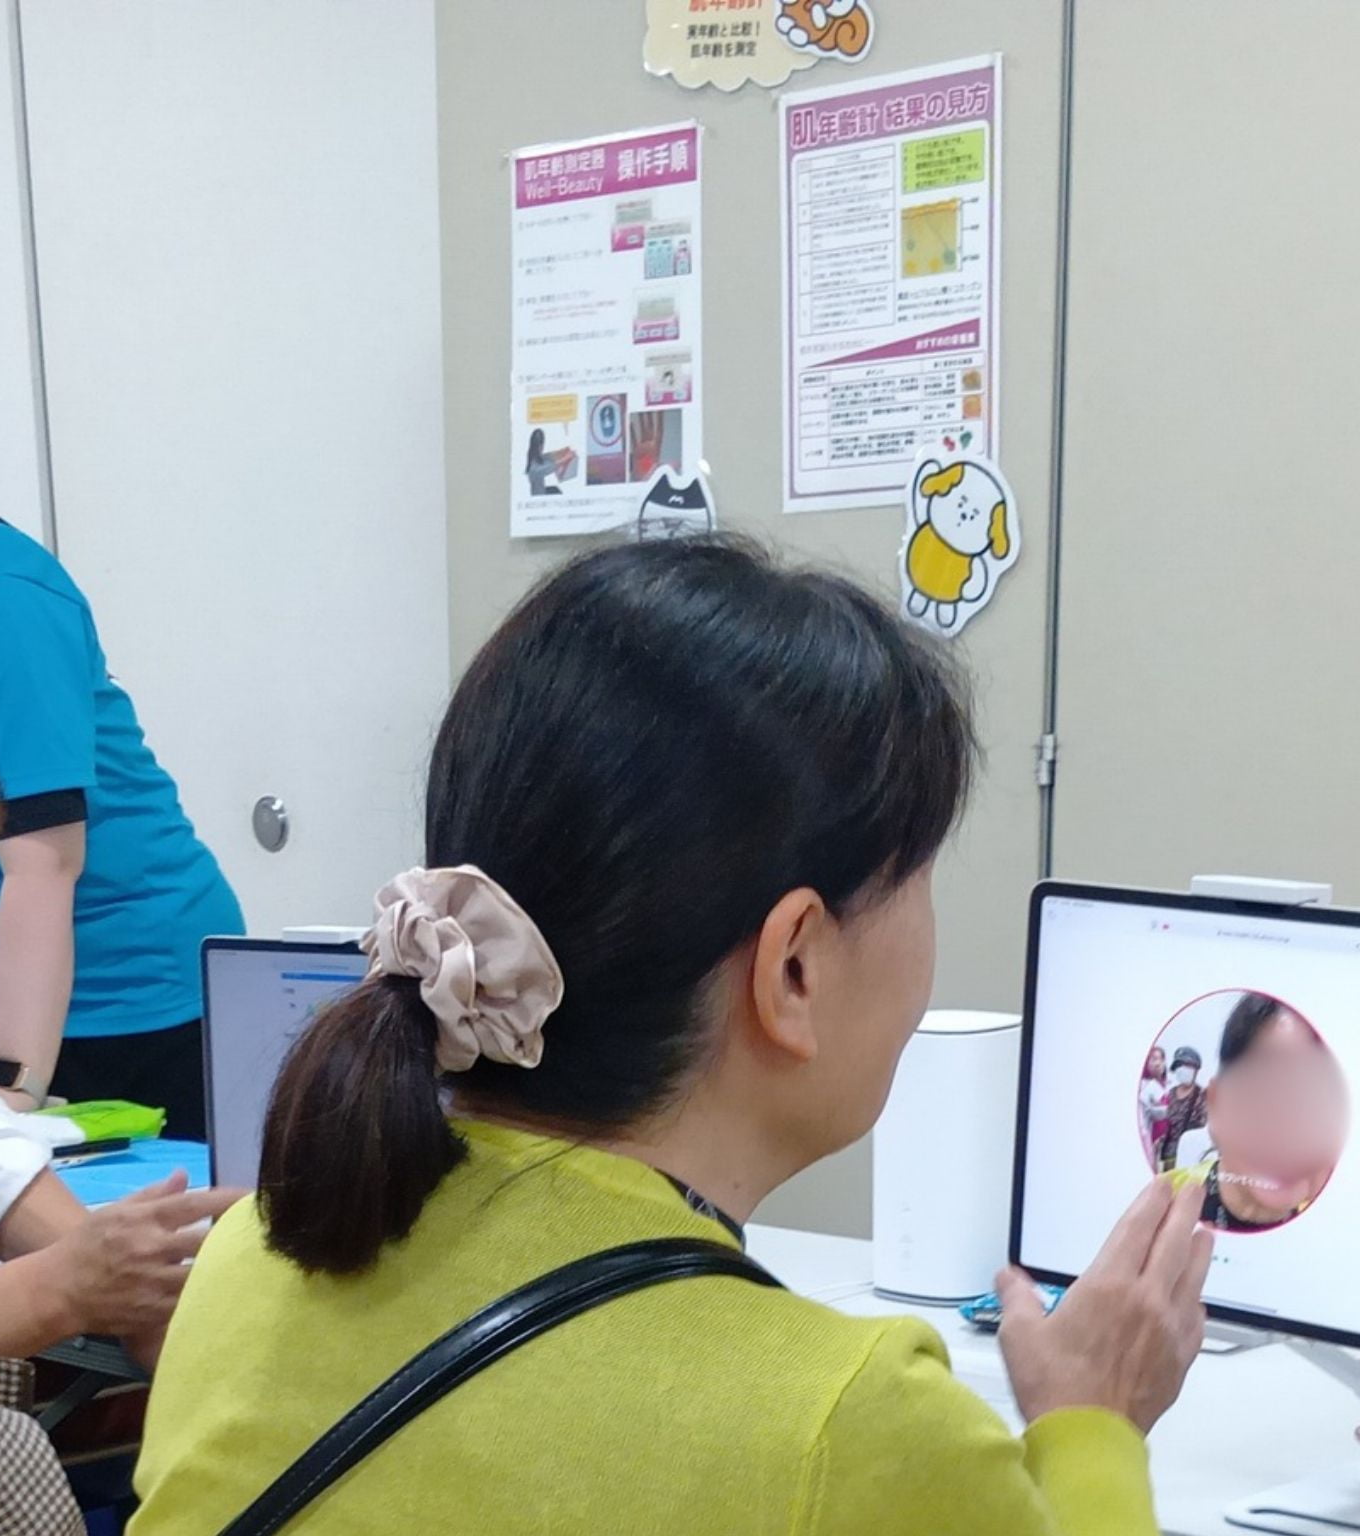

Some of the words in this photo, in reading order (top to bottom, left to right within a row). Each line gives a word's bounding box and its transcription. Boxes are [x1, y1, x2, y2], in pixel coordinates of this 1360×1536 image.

[791, 104, 878, 148] 肌年齢計
[884, 84, 989, 129] 結果の見方
[617, 140, 689, 182] 操作手順
